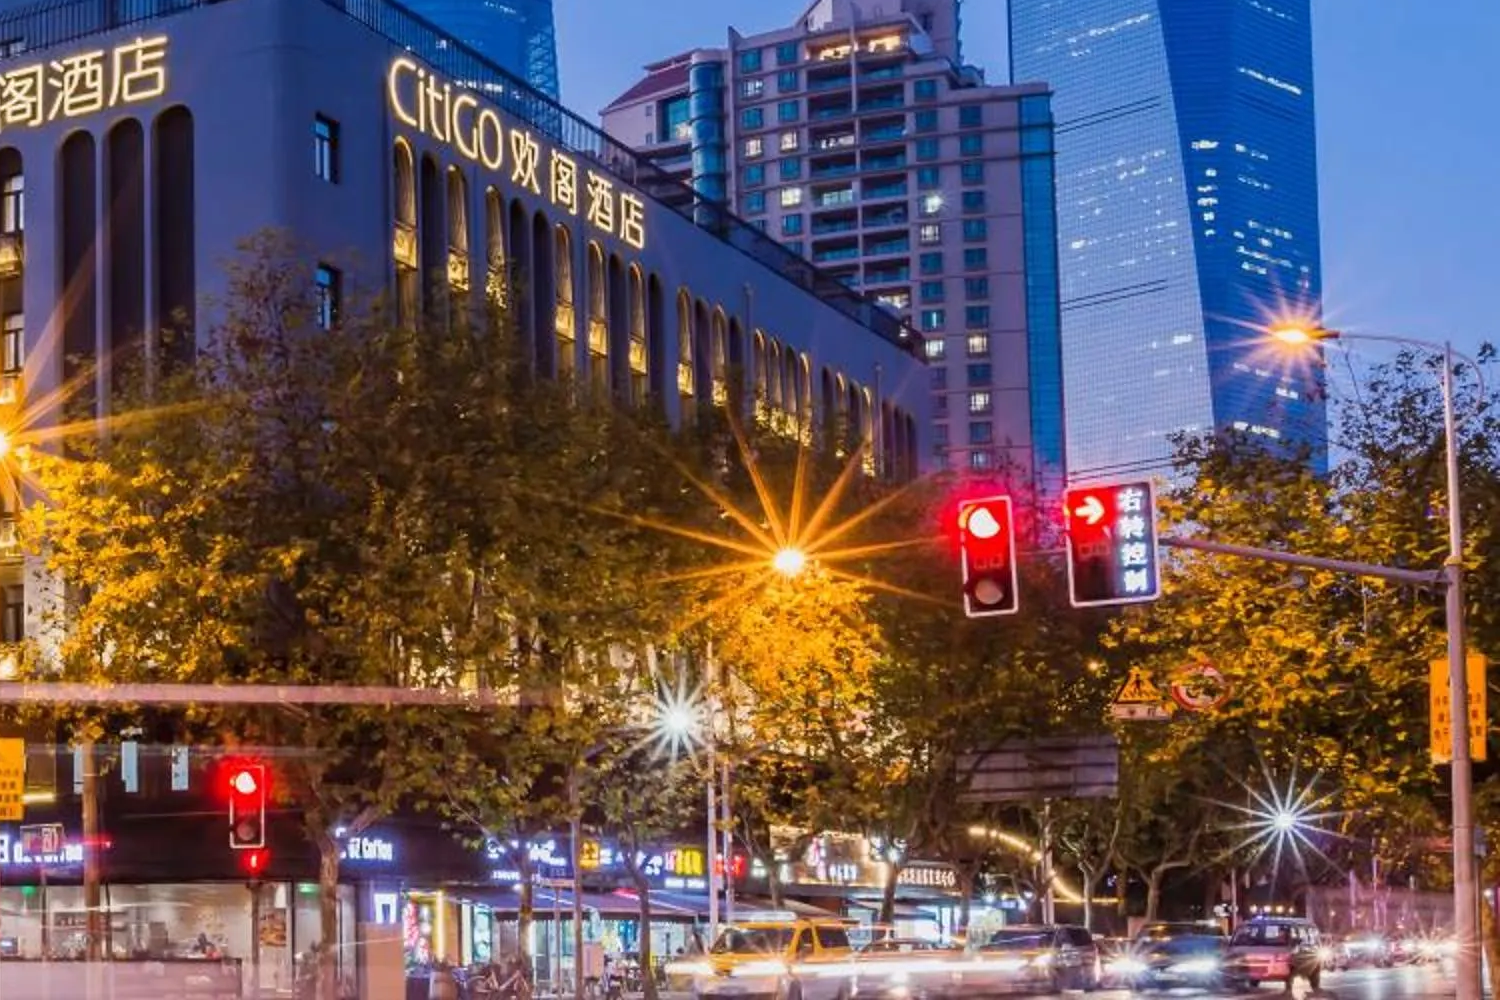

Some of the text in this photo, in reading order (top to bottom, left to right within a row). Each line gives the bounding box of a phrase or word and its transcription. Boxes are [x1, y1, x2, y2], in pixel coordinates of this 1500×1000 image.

[388, 58, 646, 249] CitiGO 欢阁酒店
